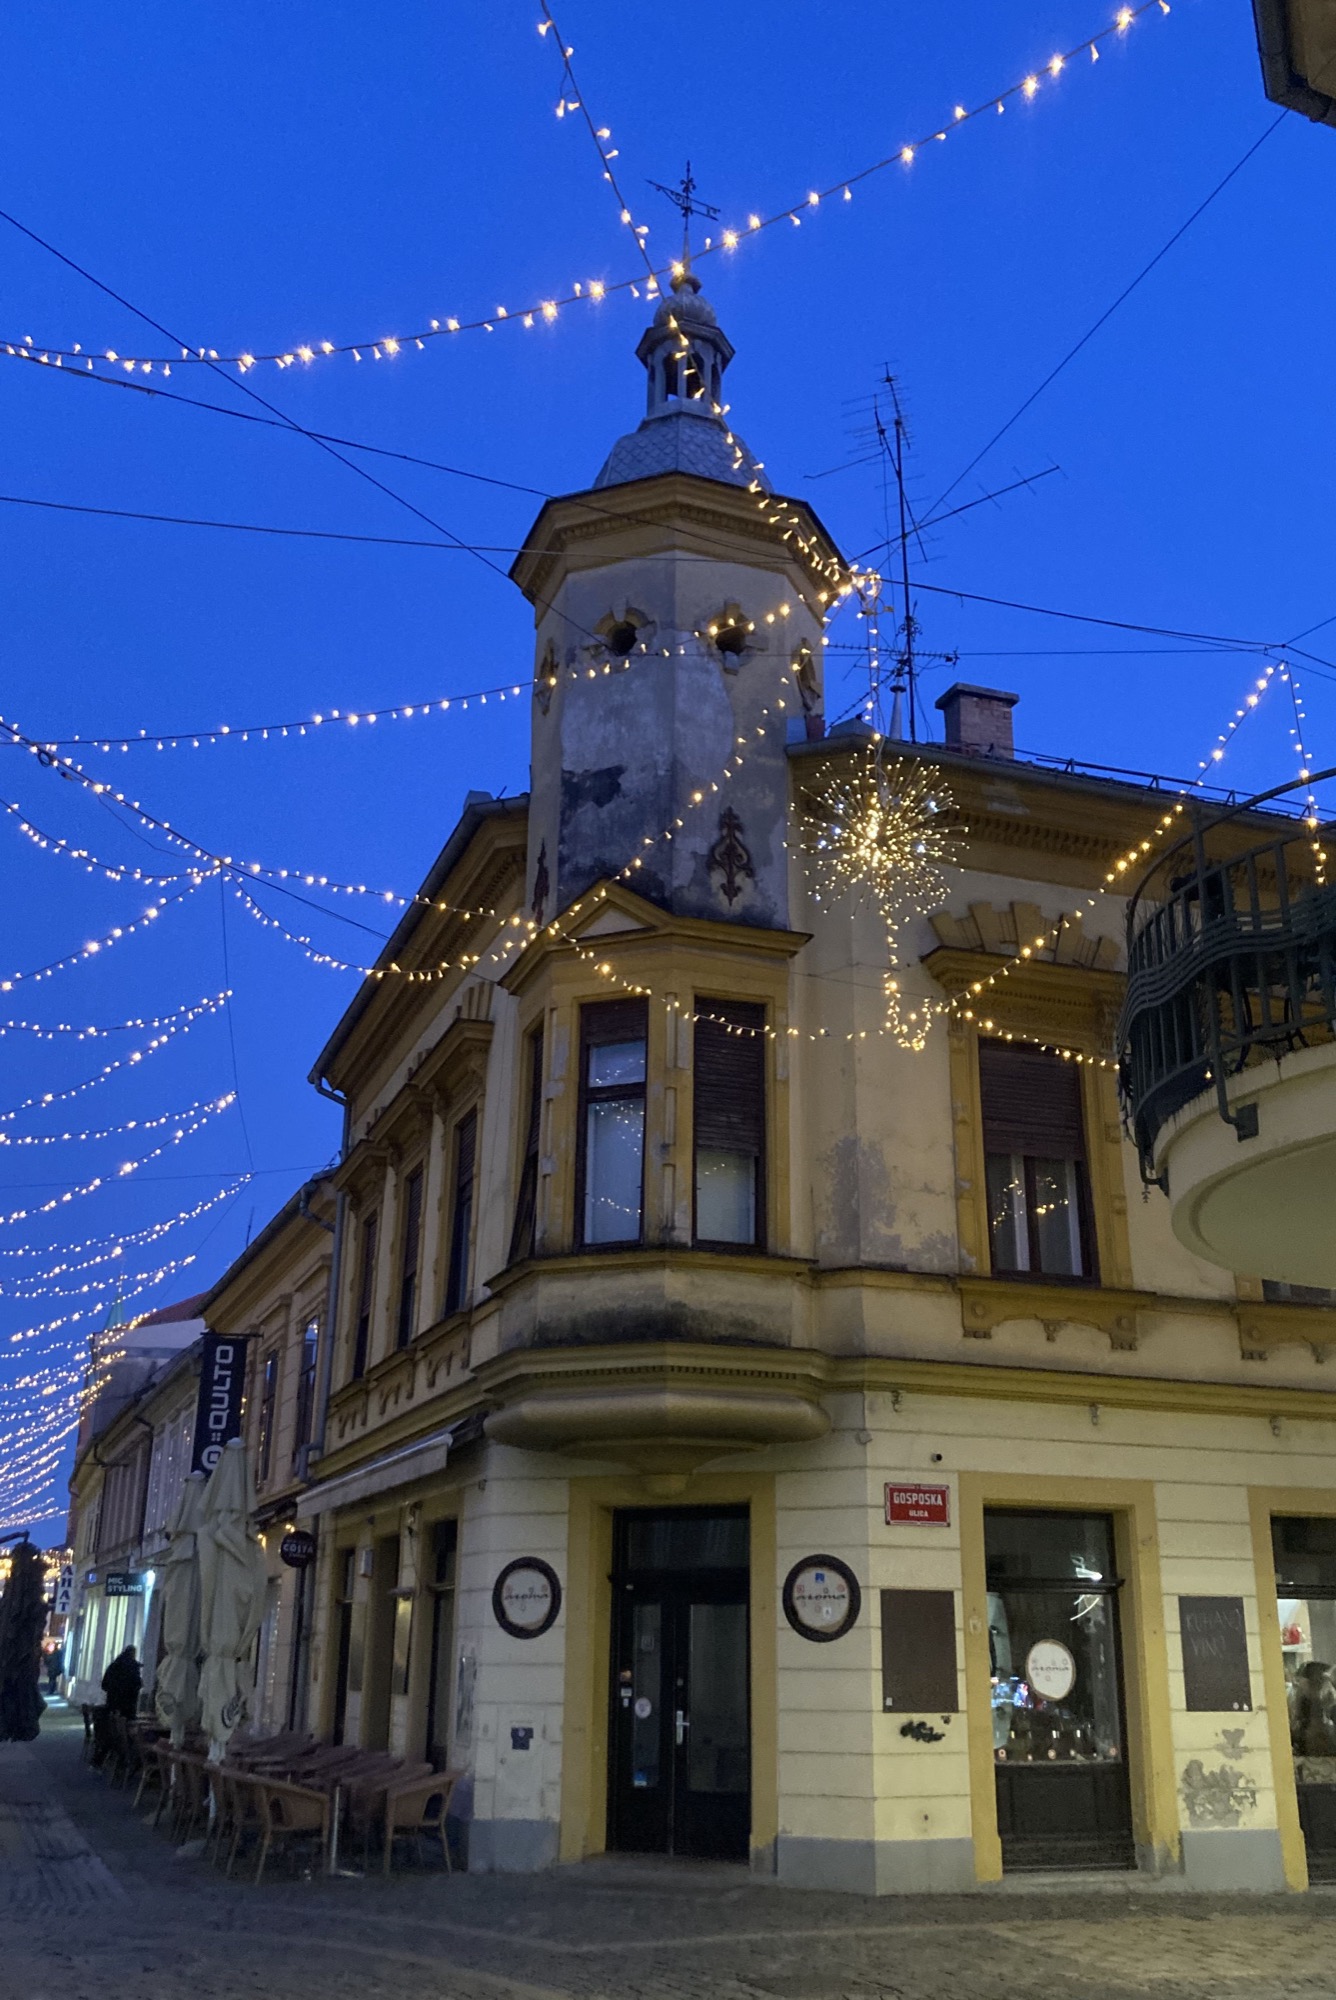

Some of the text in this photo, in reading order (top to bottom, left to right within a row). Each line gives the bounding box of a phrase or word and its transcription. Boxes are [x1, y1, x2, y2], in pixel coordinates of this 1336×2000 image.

[208, 1345, 234, 1430] QULTO
[893, 1492, 943, 1506] GOSPOSKA
[908, 1509, 929, 1517] ULICA
[282, 1543, 313, 1554] COSTA
